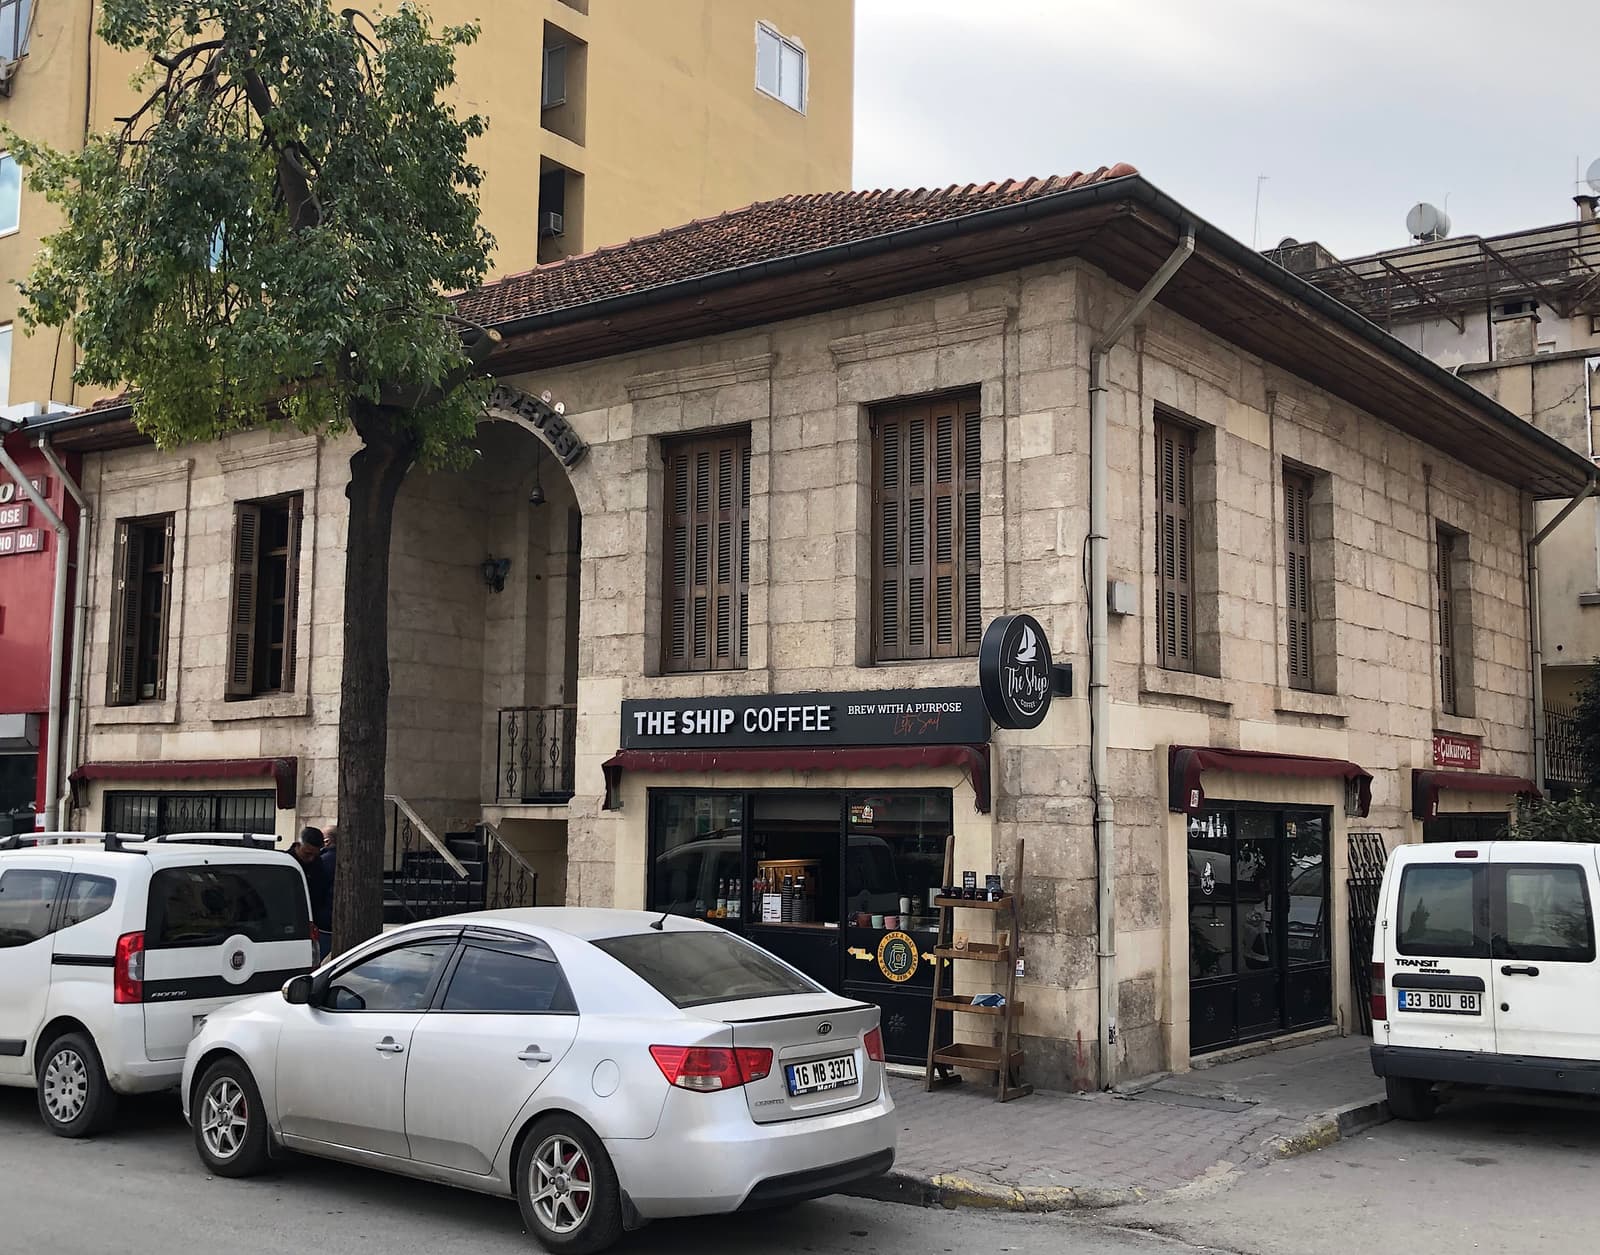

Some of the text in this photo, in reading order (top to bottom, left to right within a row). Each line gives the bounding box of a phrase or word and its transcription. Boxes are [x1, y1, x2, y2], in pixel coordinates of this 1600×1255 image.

[1004, 665, 1049, 700] The Ship
[633, 705, 831, 735] THE SHIP COFFEE
[848, 702, 962, 715] BREW WITH A PURPOSE
[1440, 738, 1471, 762] Çukurova
[1395, 959, 1439, 967] TRANSIT
[1407, 993, 1475, 1009] 33 BDU 88
[796, 1058, 853, 1086] 16 MB 3371
